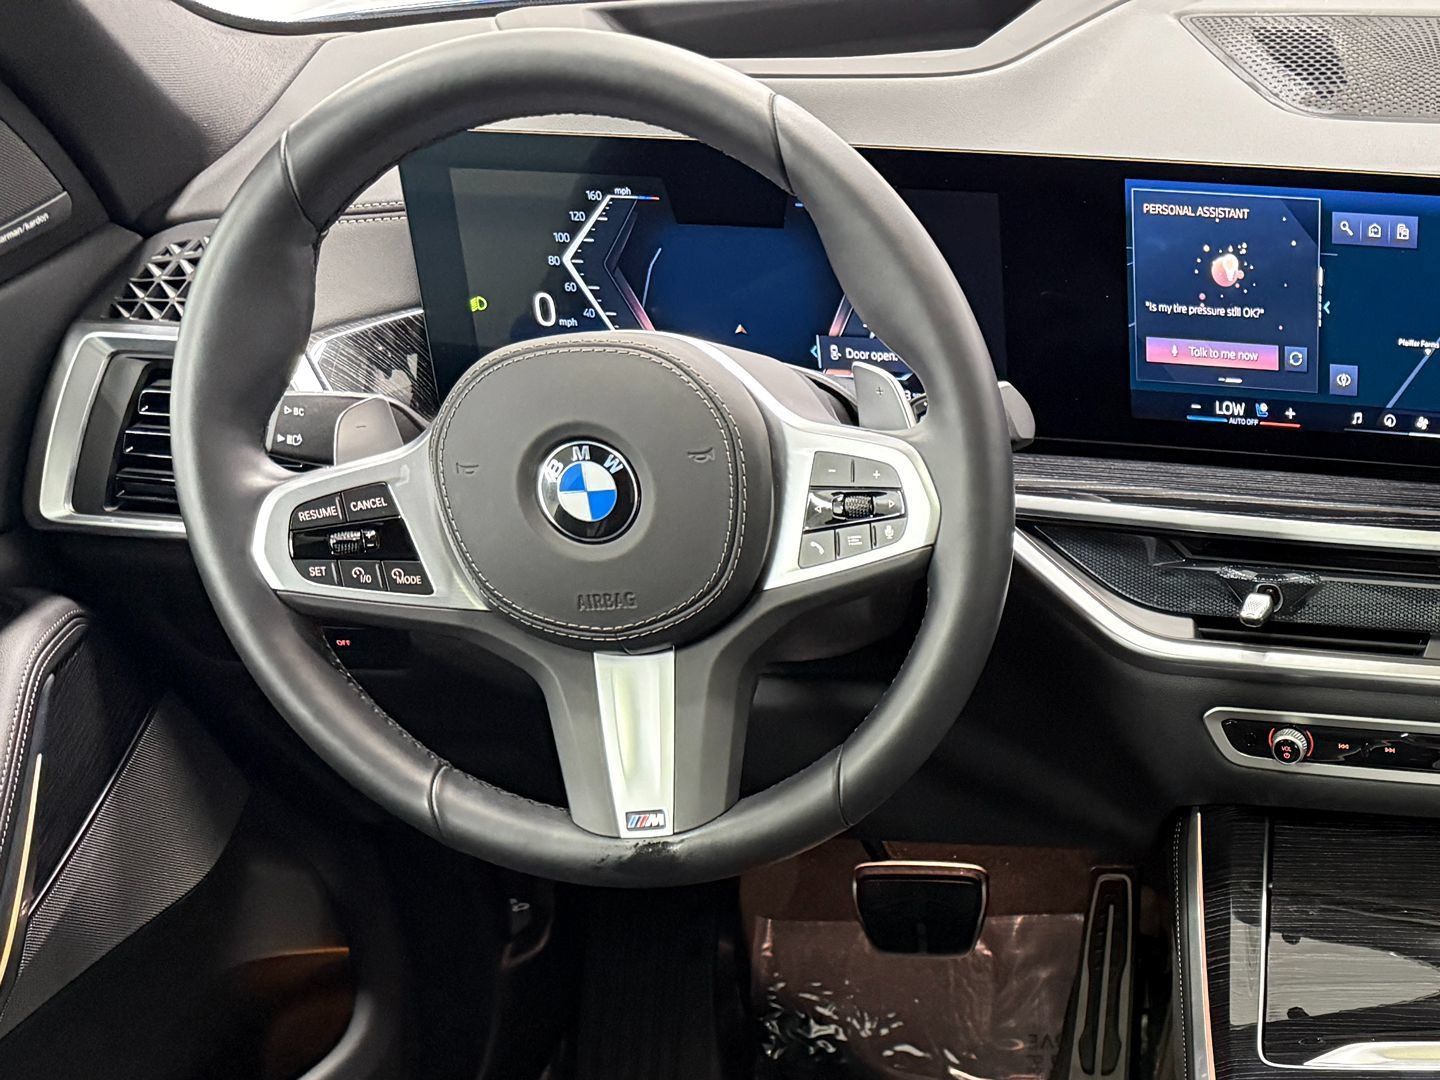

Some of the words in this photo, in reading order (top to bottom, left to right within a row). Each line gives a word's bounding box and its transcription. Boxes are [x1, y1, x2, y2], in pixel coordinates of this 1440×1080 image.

[586, 190, 601, 200] 160
[614, 187, 631, 196] mph
[569, 211, 585, 221] 120
[1143, 203, 1195, 217] PERSONAL
[1196, 207, 1249, 219] ASSISTANT
[0, 213, 49, 243] arman/kardon
[553, 233, 570, 243] 100
[548, 256, 561, 265] 80
[564, 282, 577, 292] 60
[533, 292, 556, 326] 0
[583, 308, 596, 318] 40
[1159, 304, 1172, 315] my
[1173, 303, 1187, 314] tire
[1189, 306, 1225, 316] pressure
[1227, 307, 1241, 317] still
[559, 318, 578, 327] mph
[845, 347, 870, 360] Door
[871, 352, 898, 362] open.
[1189, 346, 1208, 358] Talk
[1209, 349, 1219, 359] to
[1221, 352, 1236, 360] me
[1238, 352, 1259, 361] now
[1215, 400, 1245, 416] LOW
[1229, 417, 1246, 425] AUTO
[1247, 418, 1259, 426] OFF
[545, 445, 623, 483] BMW
[350, 497, 388, 511] CANCEL
[298, 506, 338, 521] RESUME
[309, 566, 326, 577] SET
[396, 575, 422, 585] MODE
[577, 592, 638, 611] AIRBAG
